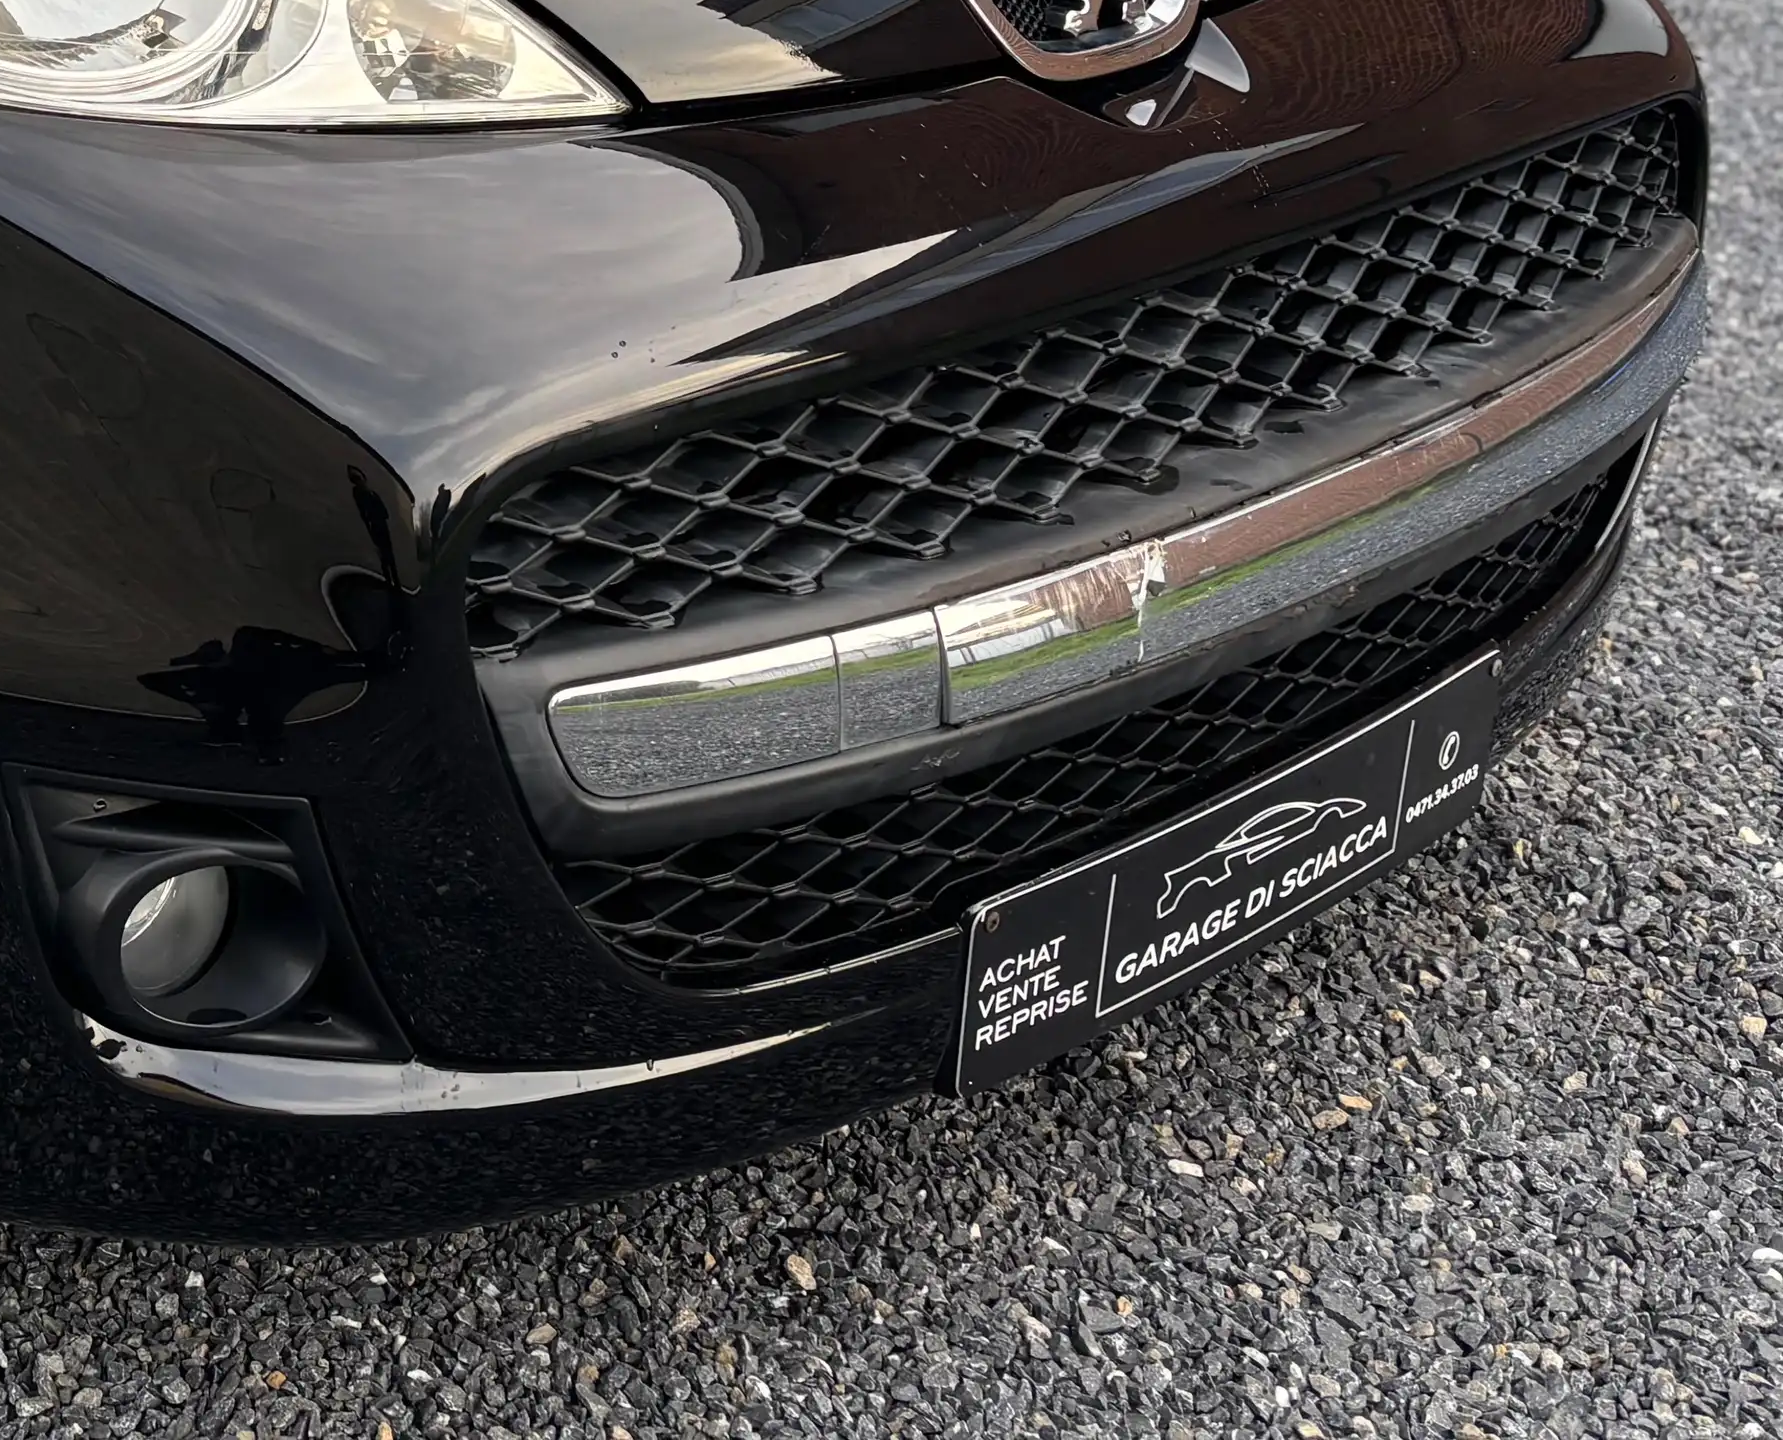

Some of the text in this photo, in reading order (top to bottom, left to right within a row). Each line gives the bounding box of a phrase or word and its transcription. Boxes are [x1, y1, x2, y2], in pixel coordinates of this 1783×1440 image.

[1405, 763, 1479, 823] 0471.34.37.03
[1114, 815, 1388, 984] GARAGE DI SCIACCA
[977, 964, 1062, 1019] VENTE
[978, 935, 1067, 993] ACHAT
[974, 980, 1090, 1051] REPRISE
